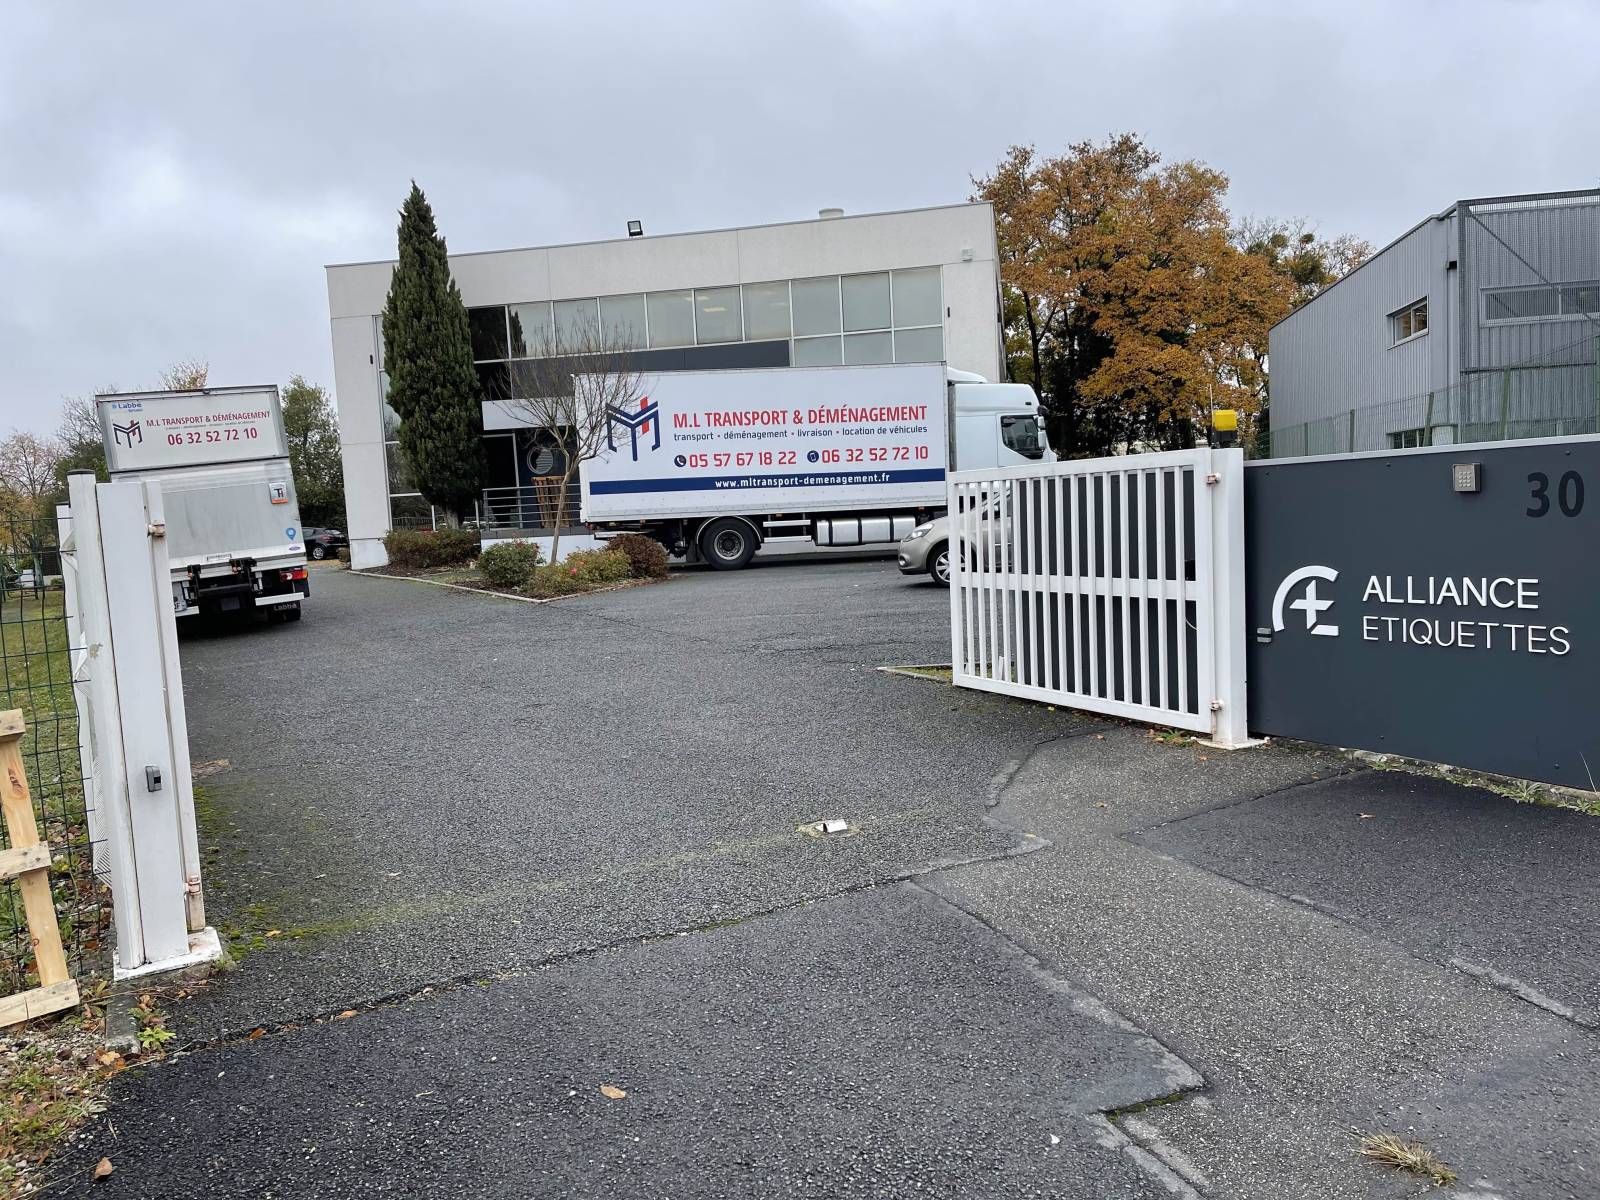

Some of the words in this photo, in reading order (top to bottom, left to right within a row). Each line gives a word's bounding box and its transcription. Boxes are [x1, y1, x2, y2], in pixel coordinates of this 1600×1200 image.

[146, 419, 160, 427] M.L
[162, 415, 203, 425] TRANSPORT
[213, 411, 270, 422] DÉMÉNAGEMENT
[673, 413, 700, 428] M.L
[704, 410, 788, 427] TRANSPORT
[793, 409, 803, 424] &
[808, 404, 927, 424] DÉMÉNAGEMENT
[168, 433, 183, 446] 06
[187, 432, 202, 444] 32
[206, 430, 221, 442] 52
[224, 429, 239, 441] 72
[243, 427, 258, 439] 10
[674, 432, 714, 442] transport
[723, 429, 788, 440] déménagement
[797, 428, 833, 437] livraison
[842, 427, 874, 436] location
[877, 426, 887, 435] de
[889, 425, 928, 434] véhicules
[689, 454, 708, 467] 05
[713, 453, 731, 467] 57
[736, 452, 753, 466] 67
[759, 452, 772, 465] 18
[778, 451, 797, 465] 22
[822, 449, 840, 463] 06
[846, 449, 863, 462] 32
[869, 447, 887, 461] 52
[892, 447, 910, 460] 72
[915, 446, 928, 459] 10
[715, 472, 890, 488] www.mltransport-demenagement.fr
[1526, 470, 1585, 518] 30
[1363, 575, 1539, 609] ALLIANCE
[1363, 615, 1570, 655] ETIQUETTES
